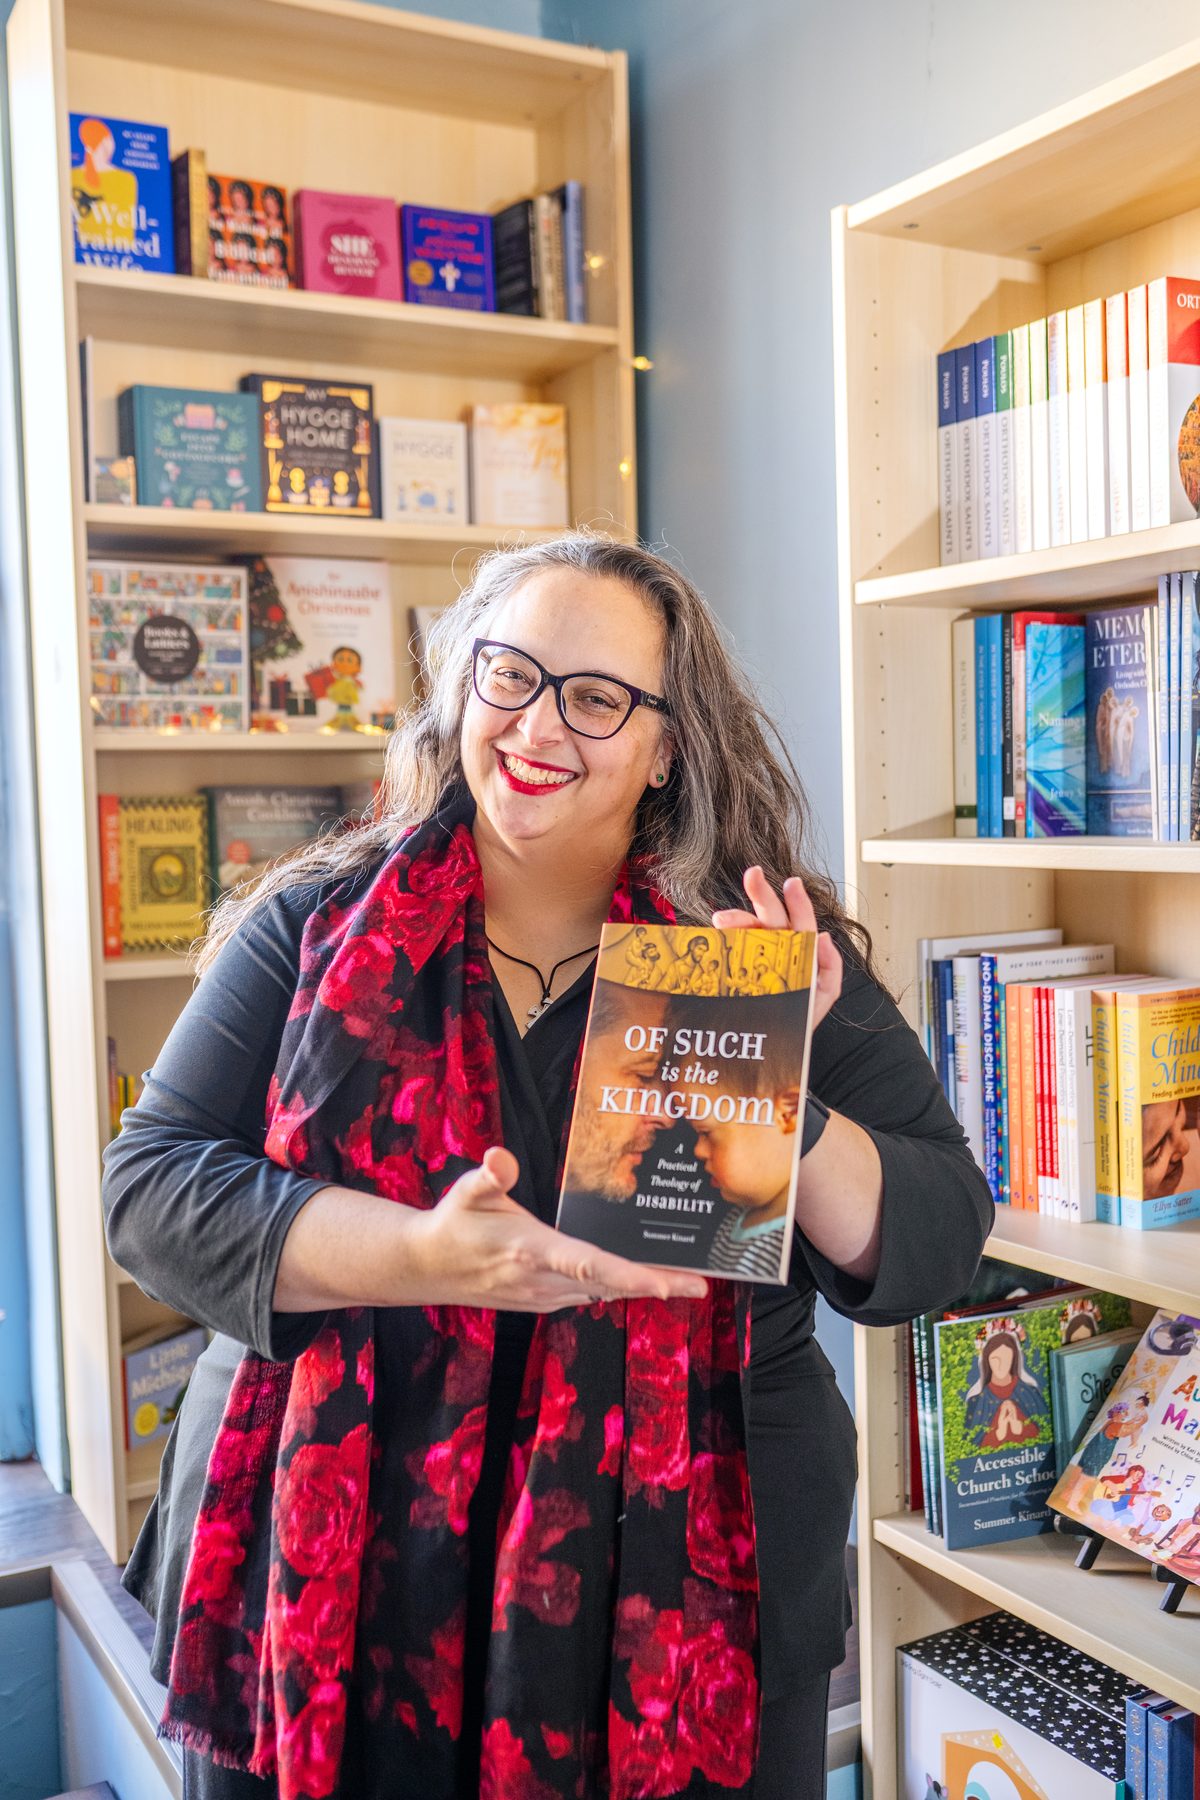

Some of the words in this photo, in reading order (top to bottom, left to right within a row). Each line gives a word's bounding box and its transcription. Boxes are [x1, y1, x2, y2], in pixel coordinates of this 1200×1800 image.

[74, 228, 161, 258] rained
[286, 425, 350, 450] HOME
[943, 430, 952, 506] ORTHODOX
[963, 426, 971, 503] ORTHODOX
[982, 420, 991, 499] ORTHODOX
[945, 510, 953, 554] SAINTS
[965, 505, 973, 551] SAINTS
[984, 501, 992, 547] SAINTS
[126, 817, 193, 834] HEALING
[982, 961, 993, 1030] NO-DRAMA
[624, 1025, 668, 1053] OF
[673, 1028, 767, 1060] SUCH
[1096, 1008, 1109, 1053] Child
[1151, 1023, 1200, 1059] Child
[661, 1061, 679, 1082] is
[684, 1062, 719, 1085] the
[984, 1032, 995, 1103] DISCIPLINE
[1152, 1090, 1172, 1099] Feeding
[675, 1143, 684, 1155] A
[657, 1158, 698, 1173] Practical
[650, 1174, 689, 1192] Theology
[690, 1180, 702, 1193] of
[1162, 1434, 1179, 1447] Written
[974, 1447, 1046, 1474] Accessible
[957, 1473, 1011, 1496] Church
[974, 1516, 1016, 1531] Summer
[1018, 1509, 1051, 1522] Kinard
